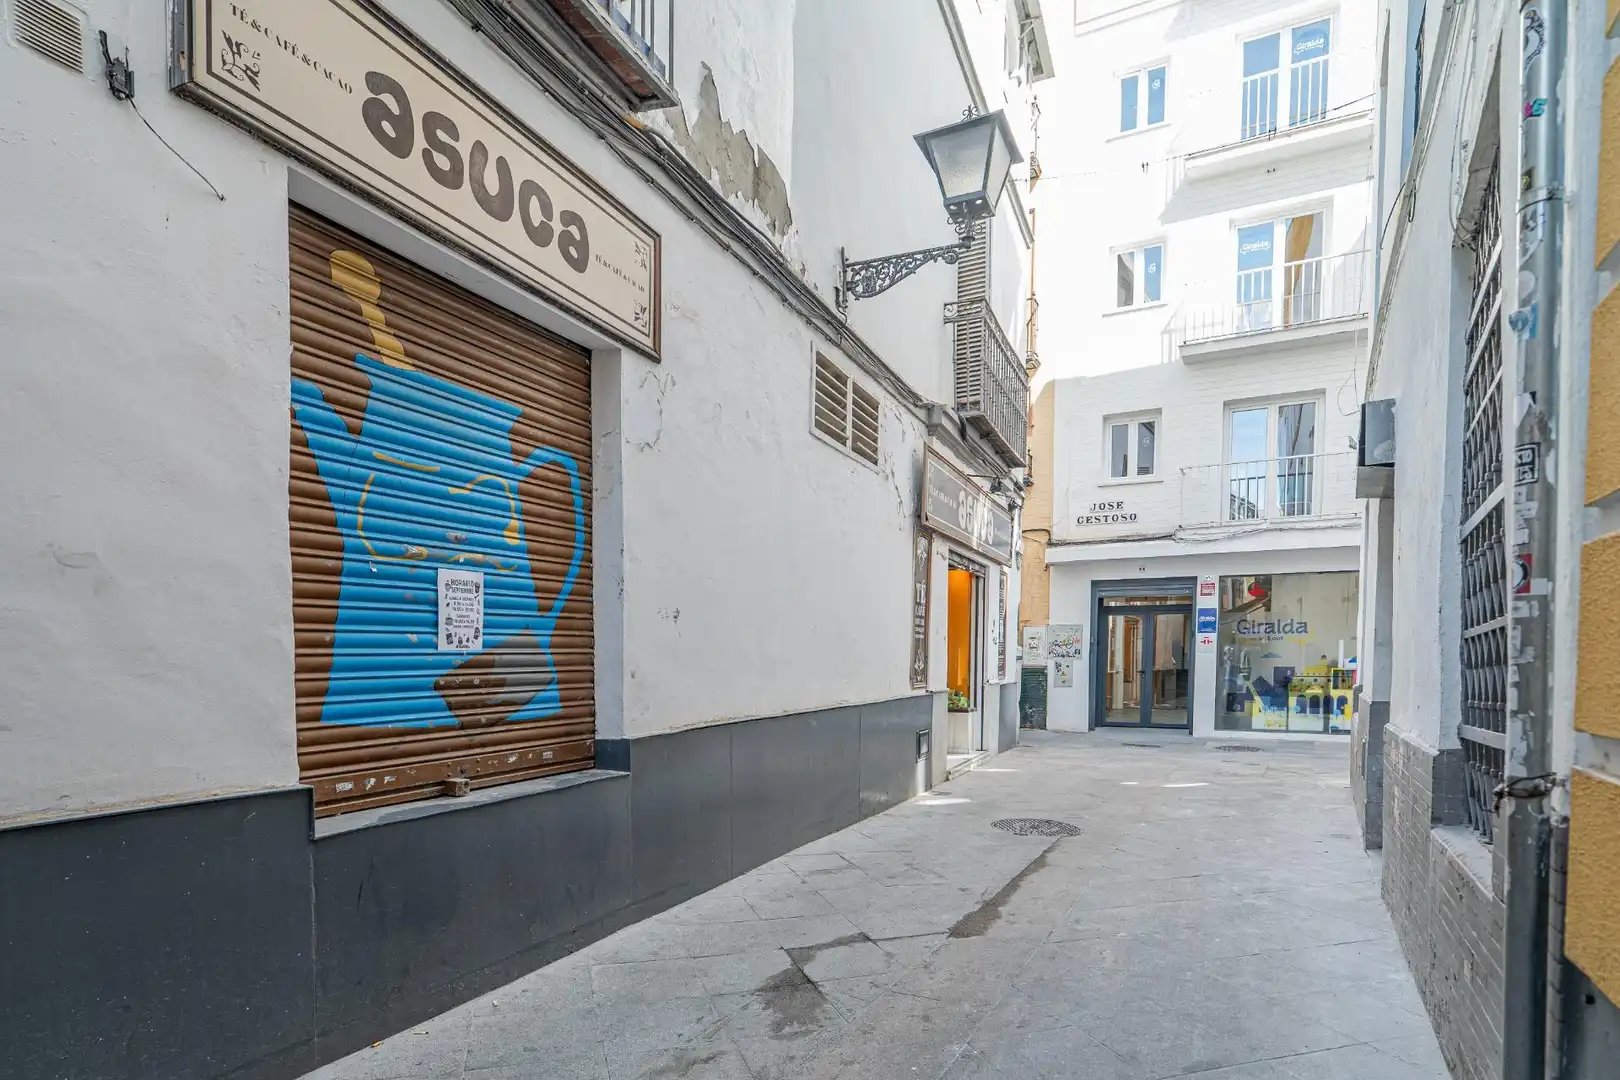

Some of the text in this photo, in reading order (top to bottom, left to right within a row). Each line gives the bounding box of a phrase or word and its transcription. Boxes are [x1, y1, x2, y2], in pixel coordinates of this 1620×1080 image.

[362, 71, 589, 273] asuca
[1090, 501, 1124, 511] JOSE
[1077, 513, 1137, 524] GESTOSO
[451, 579, 475, 587] HORARIO
[1237, 618, 1308, 634] Giralda
